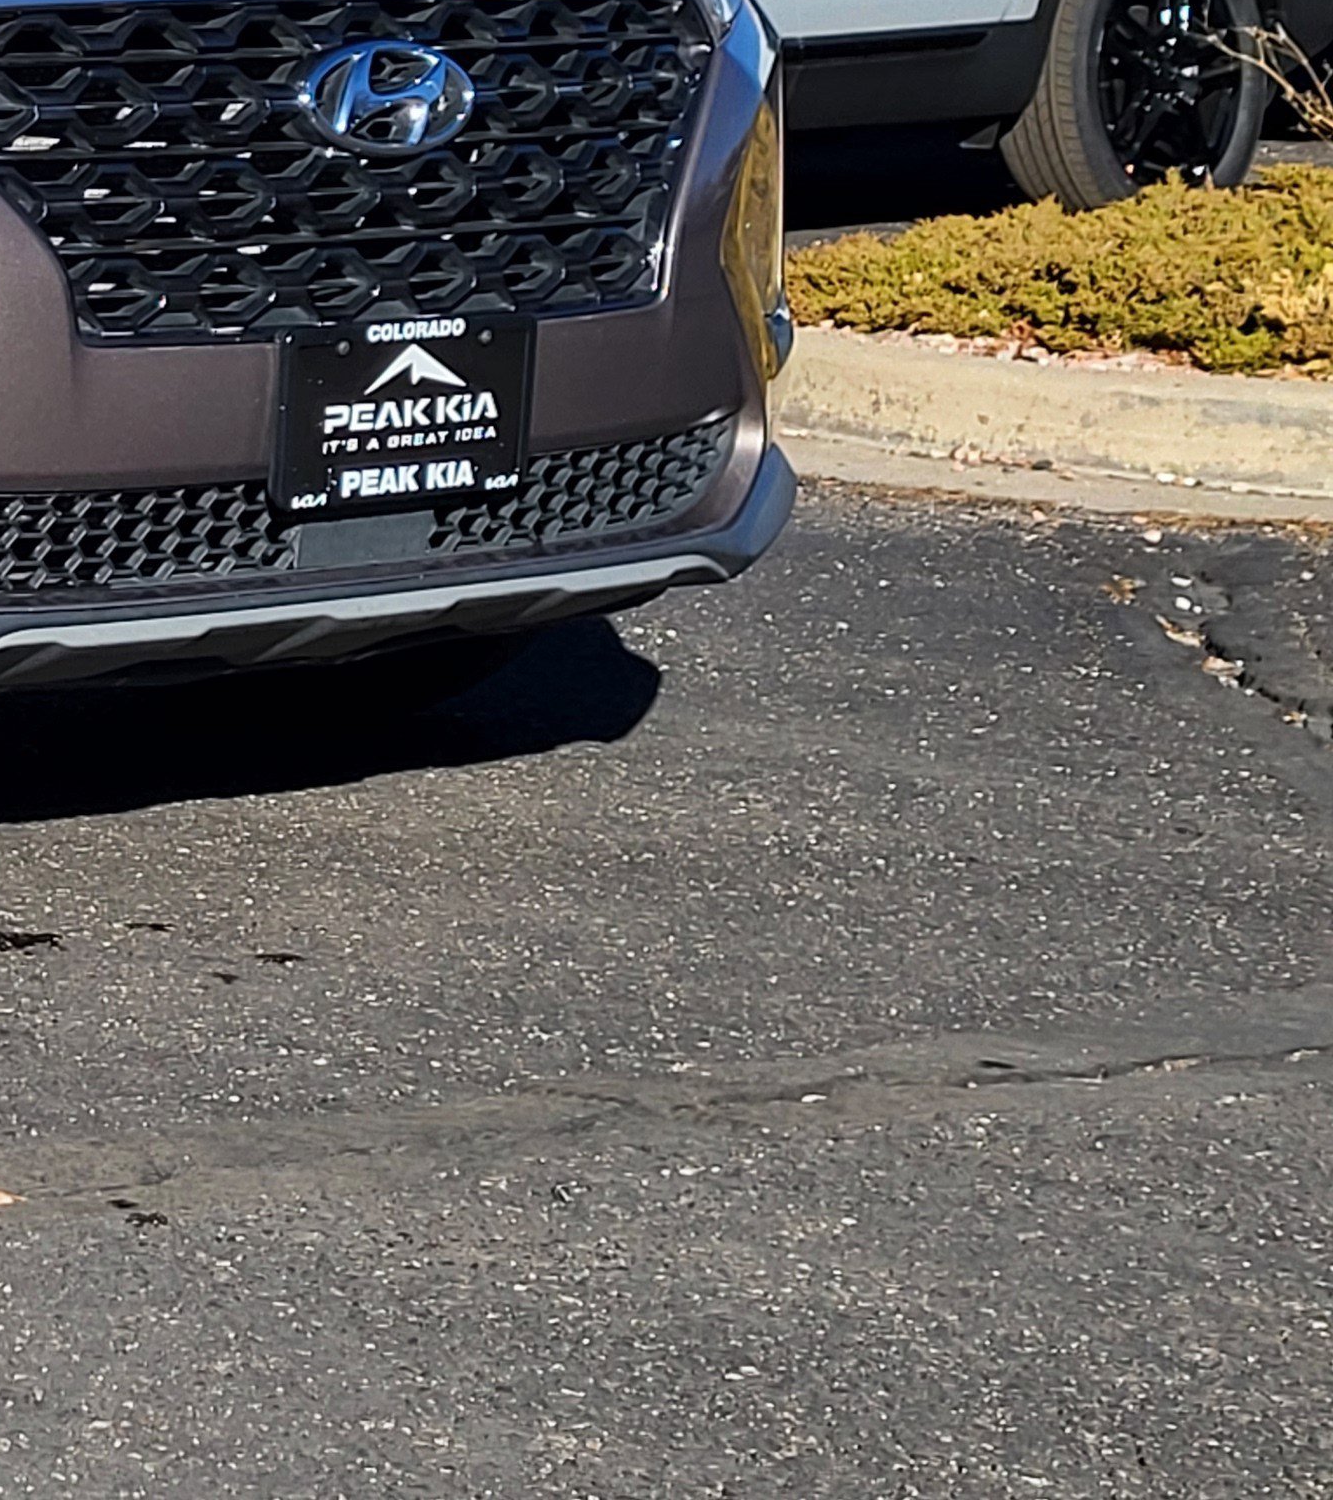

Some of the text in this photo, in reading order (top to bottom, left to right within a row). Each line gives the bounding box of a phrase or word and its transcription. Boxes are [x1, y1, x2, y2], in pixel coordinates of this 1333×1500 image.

[366, 318, 467, 343] COLORADO
[323, 398, 432, 434] PEAK
[322, 426, 497, 455] IT'S A GREAT IDEA
[341, 459, 475, 498] PEAK KIA
